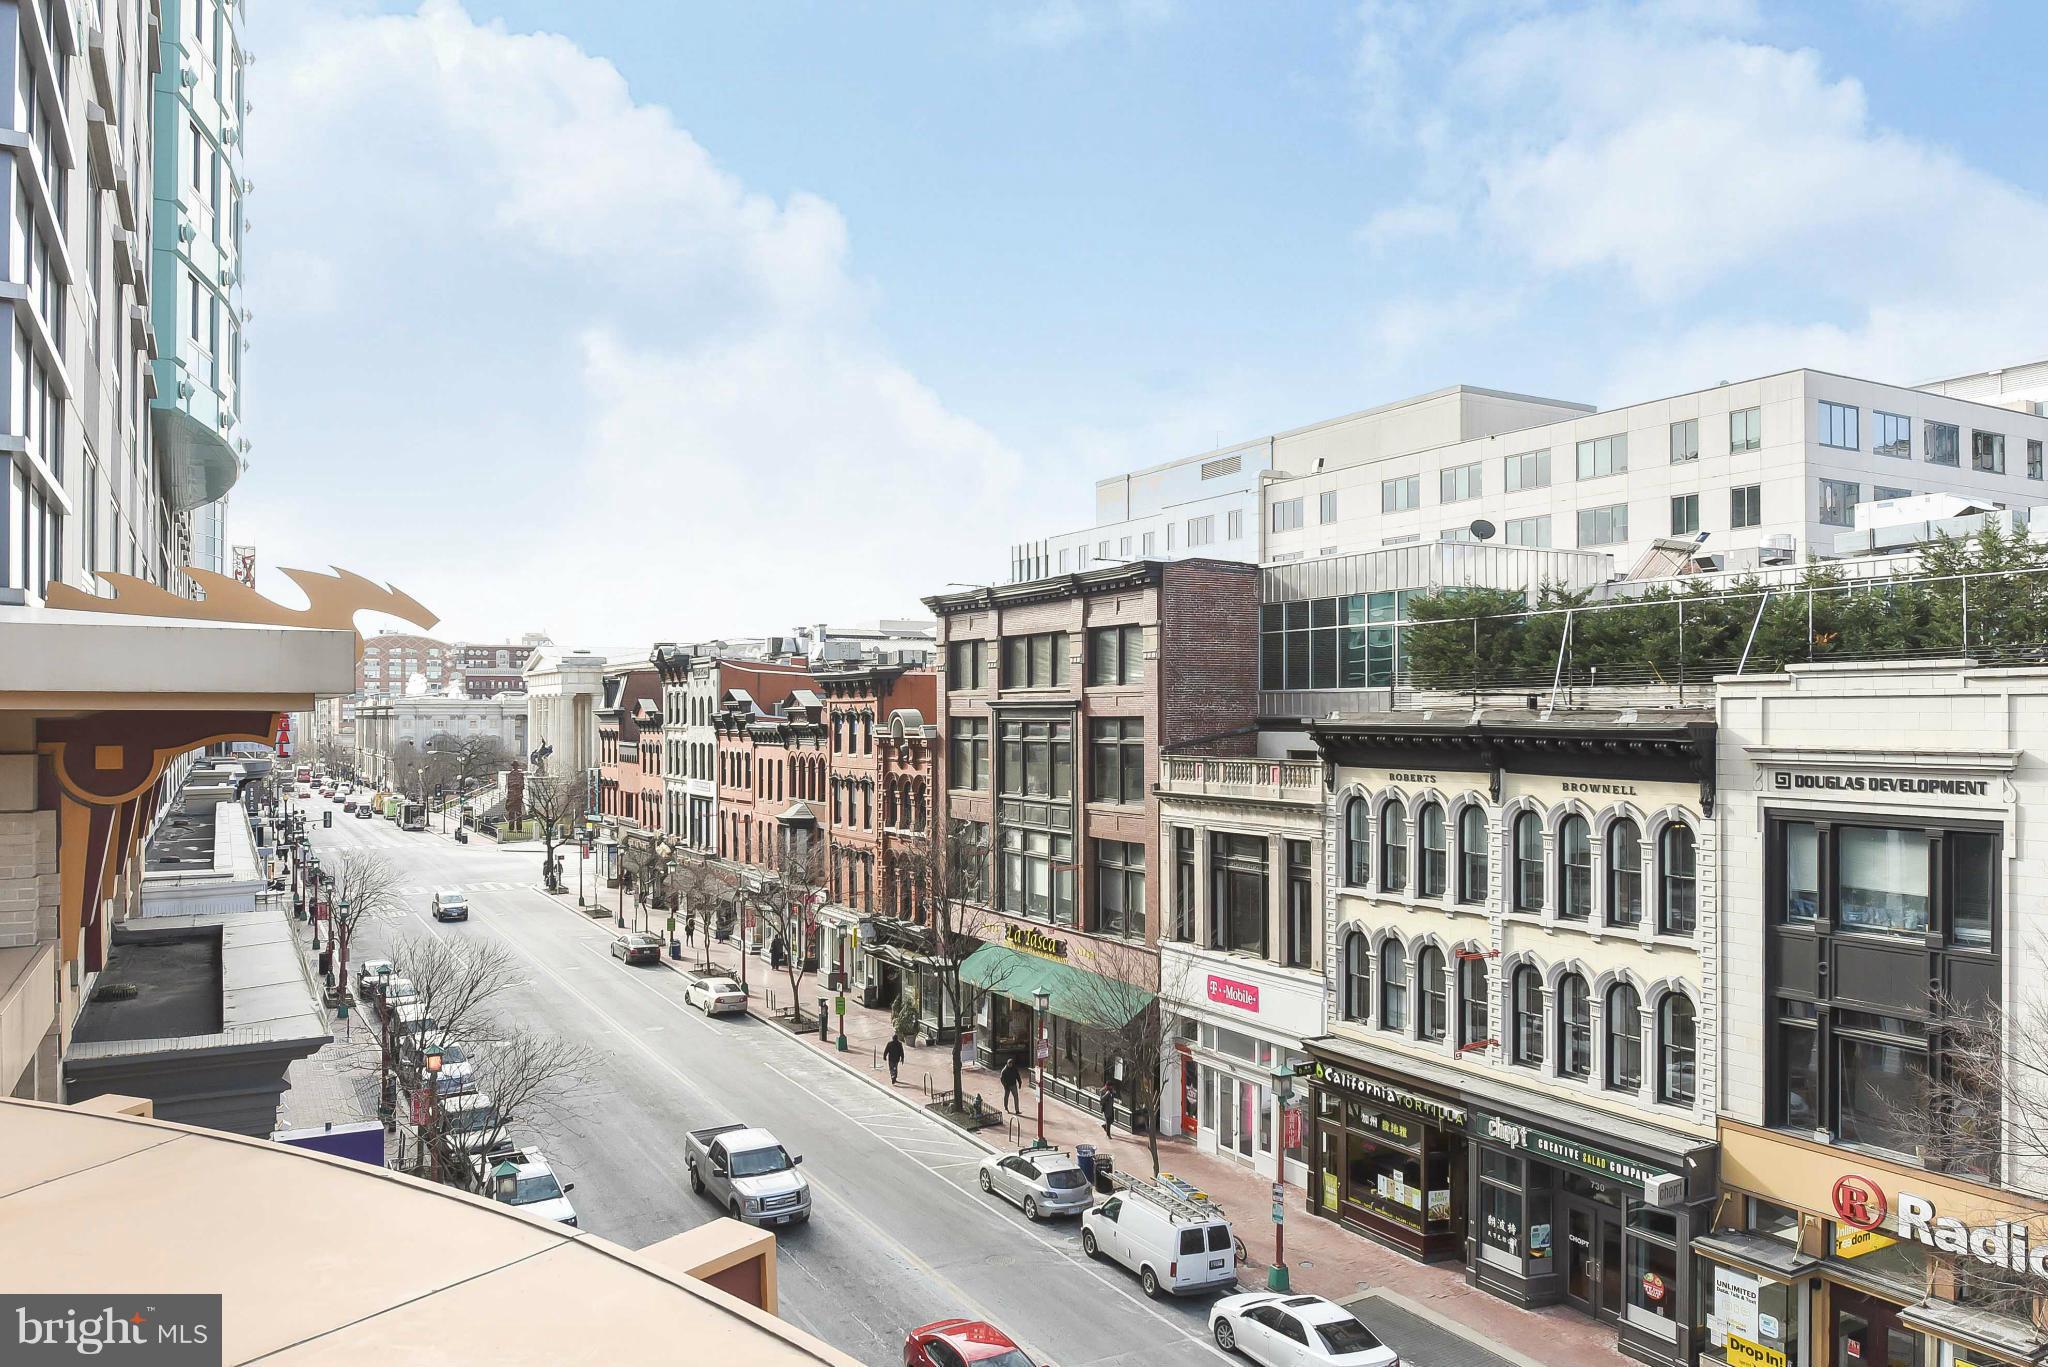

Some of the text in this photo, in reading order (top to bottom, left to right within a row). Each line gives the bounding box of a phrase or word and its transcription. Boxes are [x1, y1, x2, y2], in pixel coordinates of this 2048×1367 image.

[1389, 773, 1437, 784] ROBERTS
[1794, 774, 1989, 795] DOUGLAS DEVELOPMENT
[1562, 782, 1637, 796] BROWNELL
[1006, 923, 1021, 943] La
[1024, 928, 1056, 952] Tasca
[1324, 1068, 1465, 1127] California TORTILLA
[1538, 1138, 1579, 1161] CREATIVE
[1582, 1153, 1606, 1169] SALAD
[1609, 1161, 1654, 1181] COMPANY
[1591, 1180, 1605, 1192] 730
[1568, 1234, 1590, 1248] CHOPT
[1716, 1279, 1757, 1299] UNLIMITED
[1730, 1337, 1764, 1362] Drop
